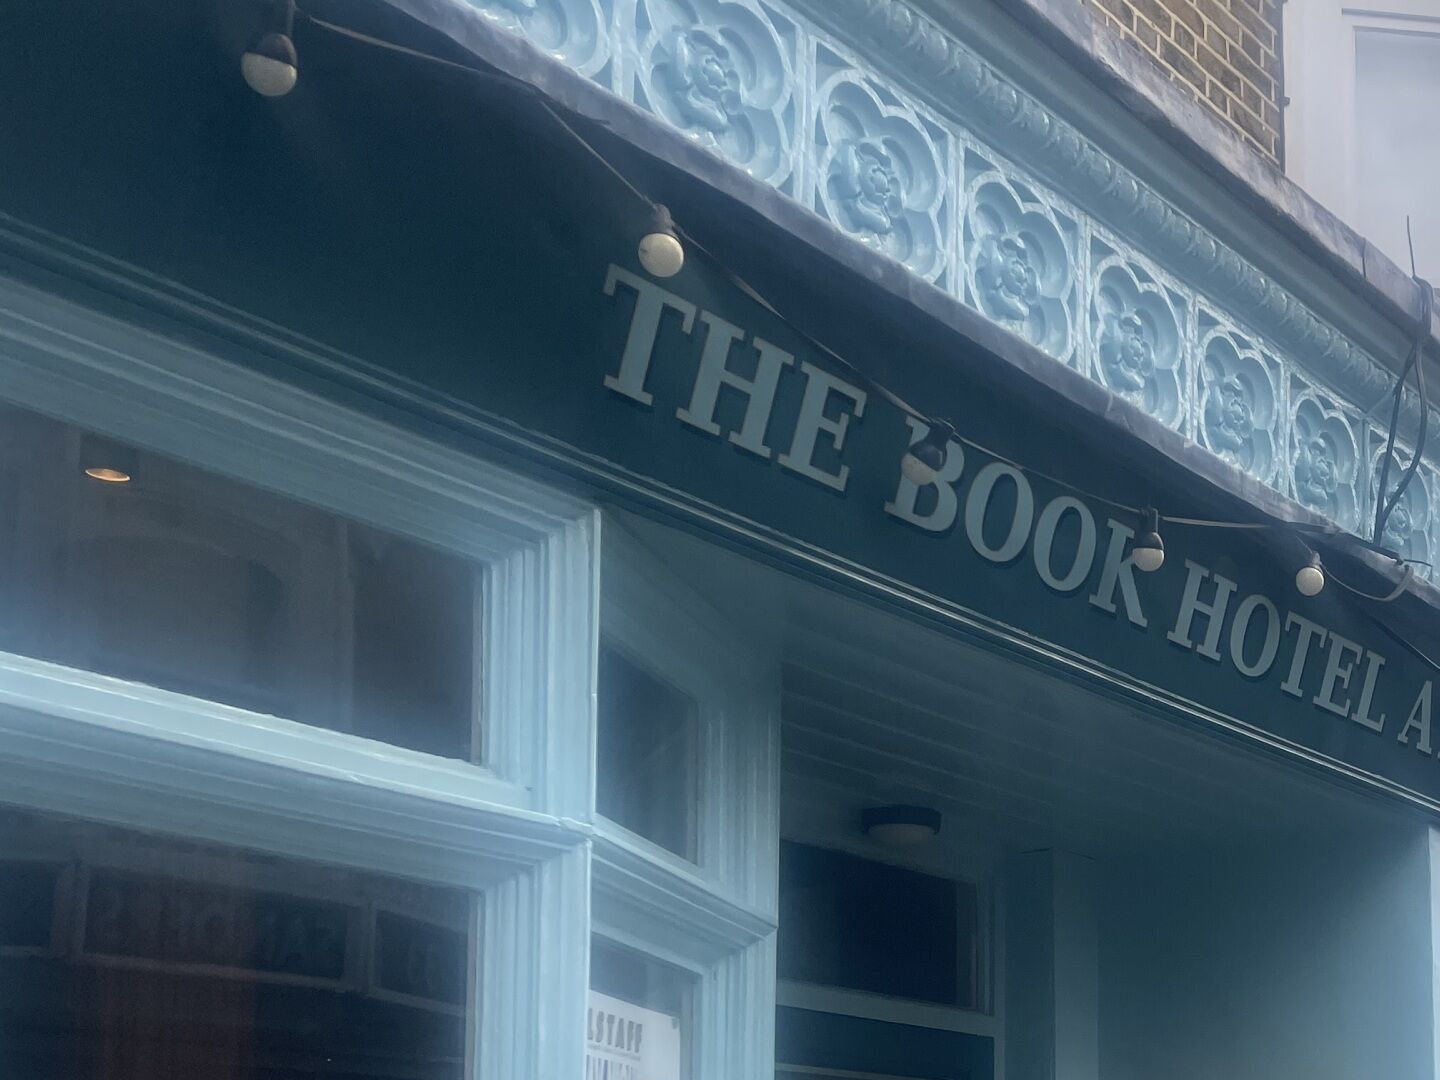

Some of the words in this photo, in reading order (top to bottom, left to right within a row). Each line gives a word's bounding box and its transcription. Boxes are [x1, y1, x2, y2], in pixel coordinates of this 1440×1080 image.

[602, 262, 867, 493] THE
[884, 413, 1149, 628] BOOK
[1166, 558, 1386, 733] HOTEL
